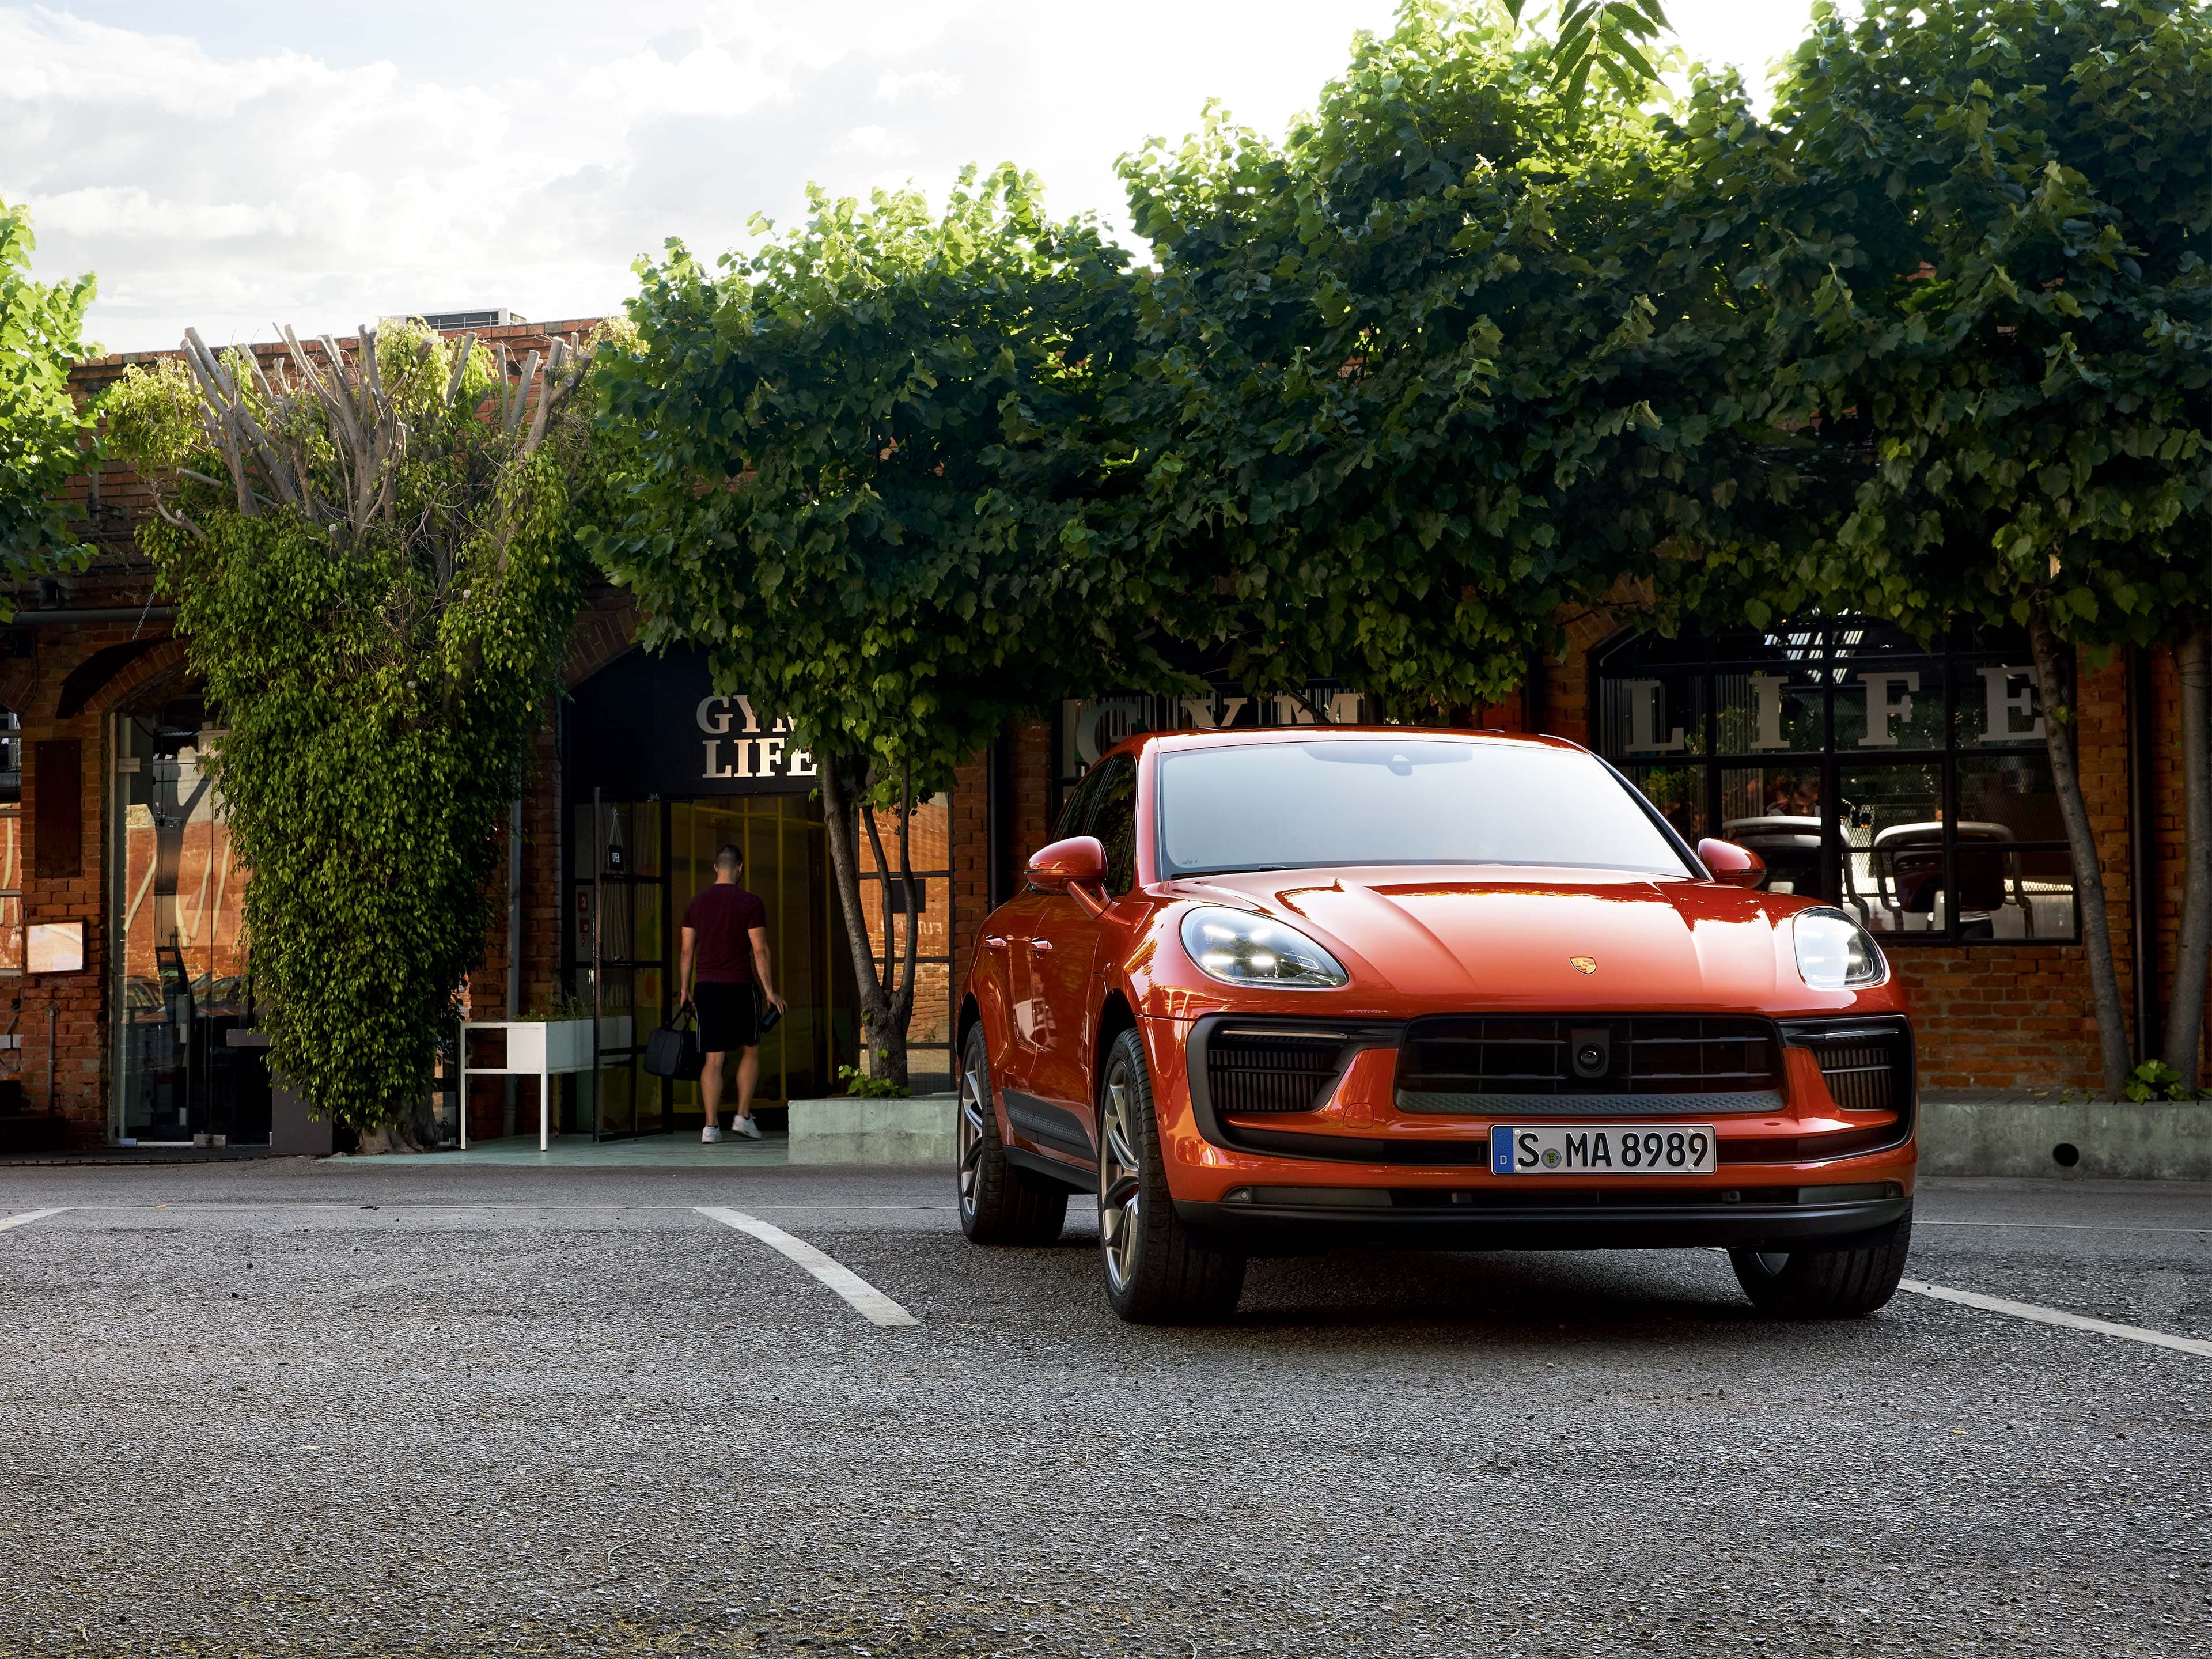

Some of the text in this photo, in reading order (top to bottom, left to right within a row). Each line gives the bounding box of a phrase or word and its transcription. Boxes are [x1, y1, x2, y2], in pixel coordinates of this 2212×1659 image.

[1623, 666, 2046, 752] LIFE
[702, 738, 817, 778] LIFE
[1499, 1155, 1507, 1165] D
[1518, 1132, 1540, 1167] S
[1566, 1132, 1612, 1167] MA
[1621, 1132, 1709, 1167] 8989
